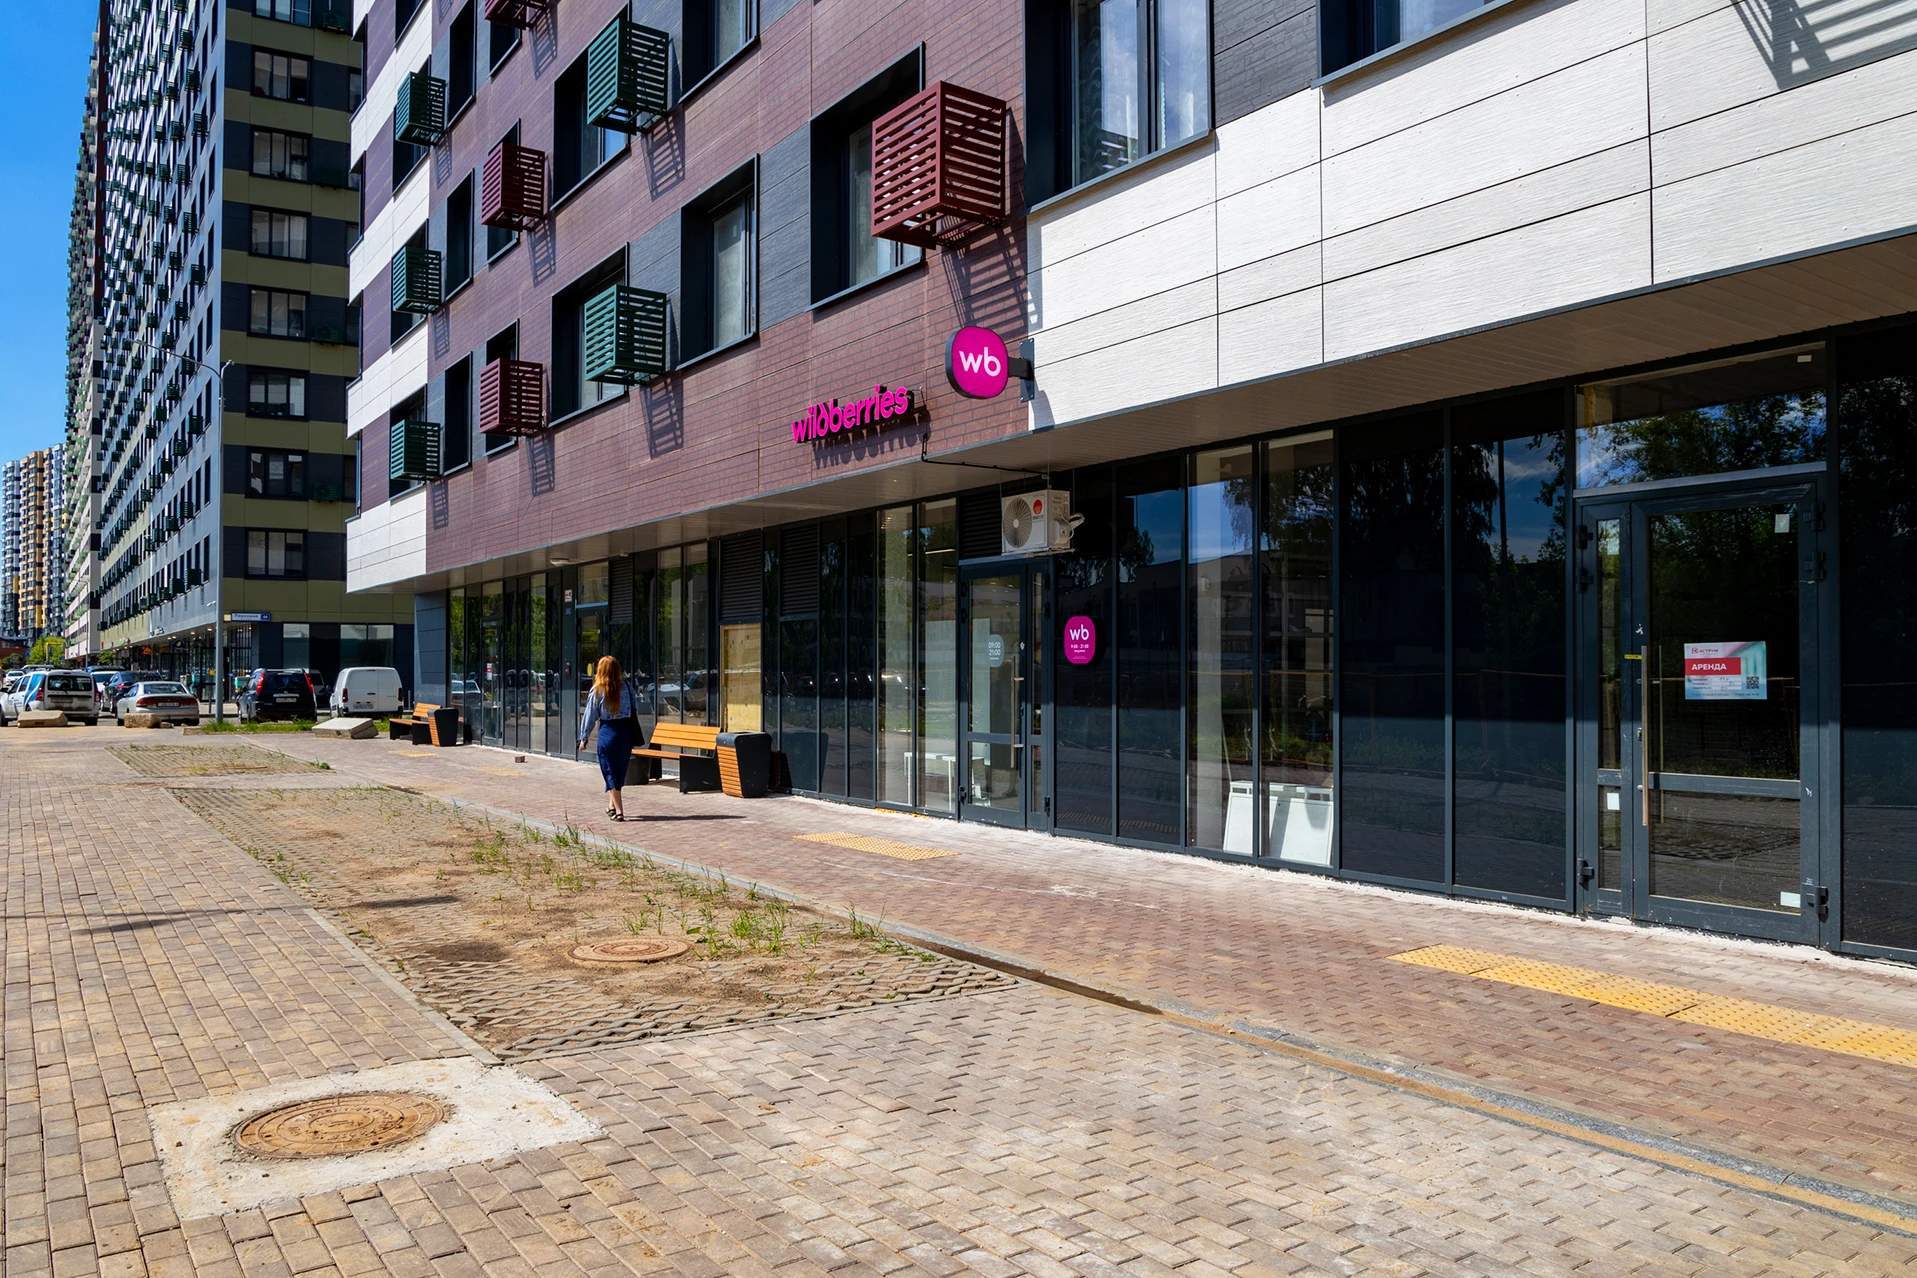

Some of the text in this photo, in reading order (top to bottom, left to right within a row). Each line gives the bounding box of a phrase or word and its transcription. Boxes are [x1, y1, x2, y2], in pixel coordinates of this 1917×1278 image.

[959, 347, 1002, 377] wb
[792, 385, 908, 443] wildberries
[1070, 624, 1089, 641] wb
[1691, 663, 1727, 671] АРЕНДА
